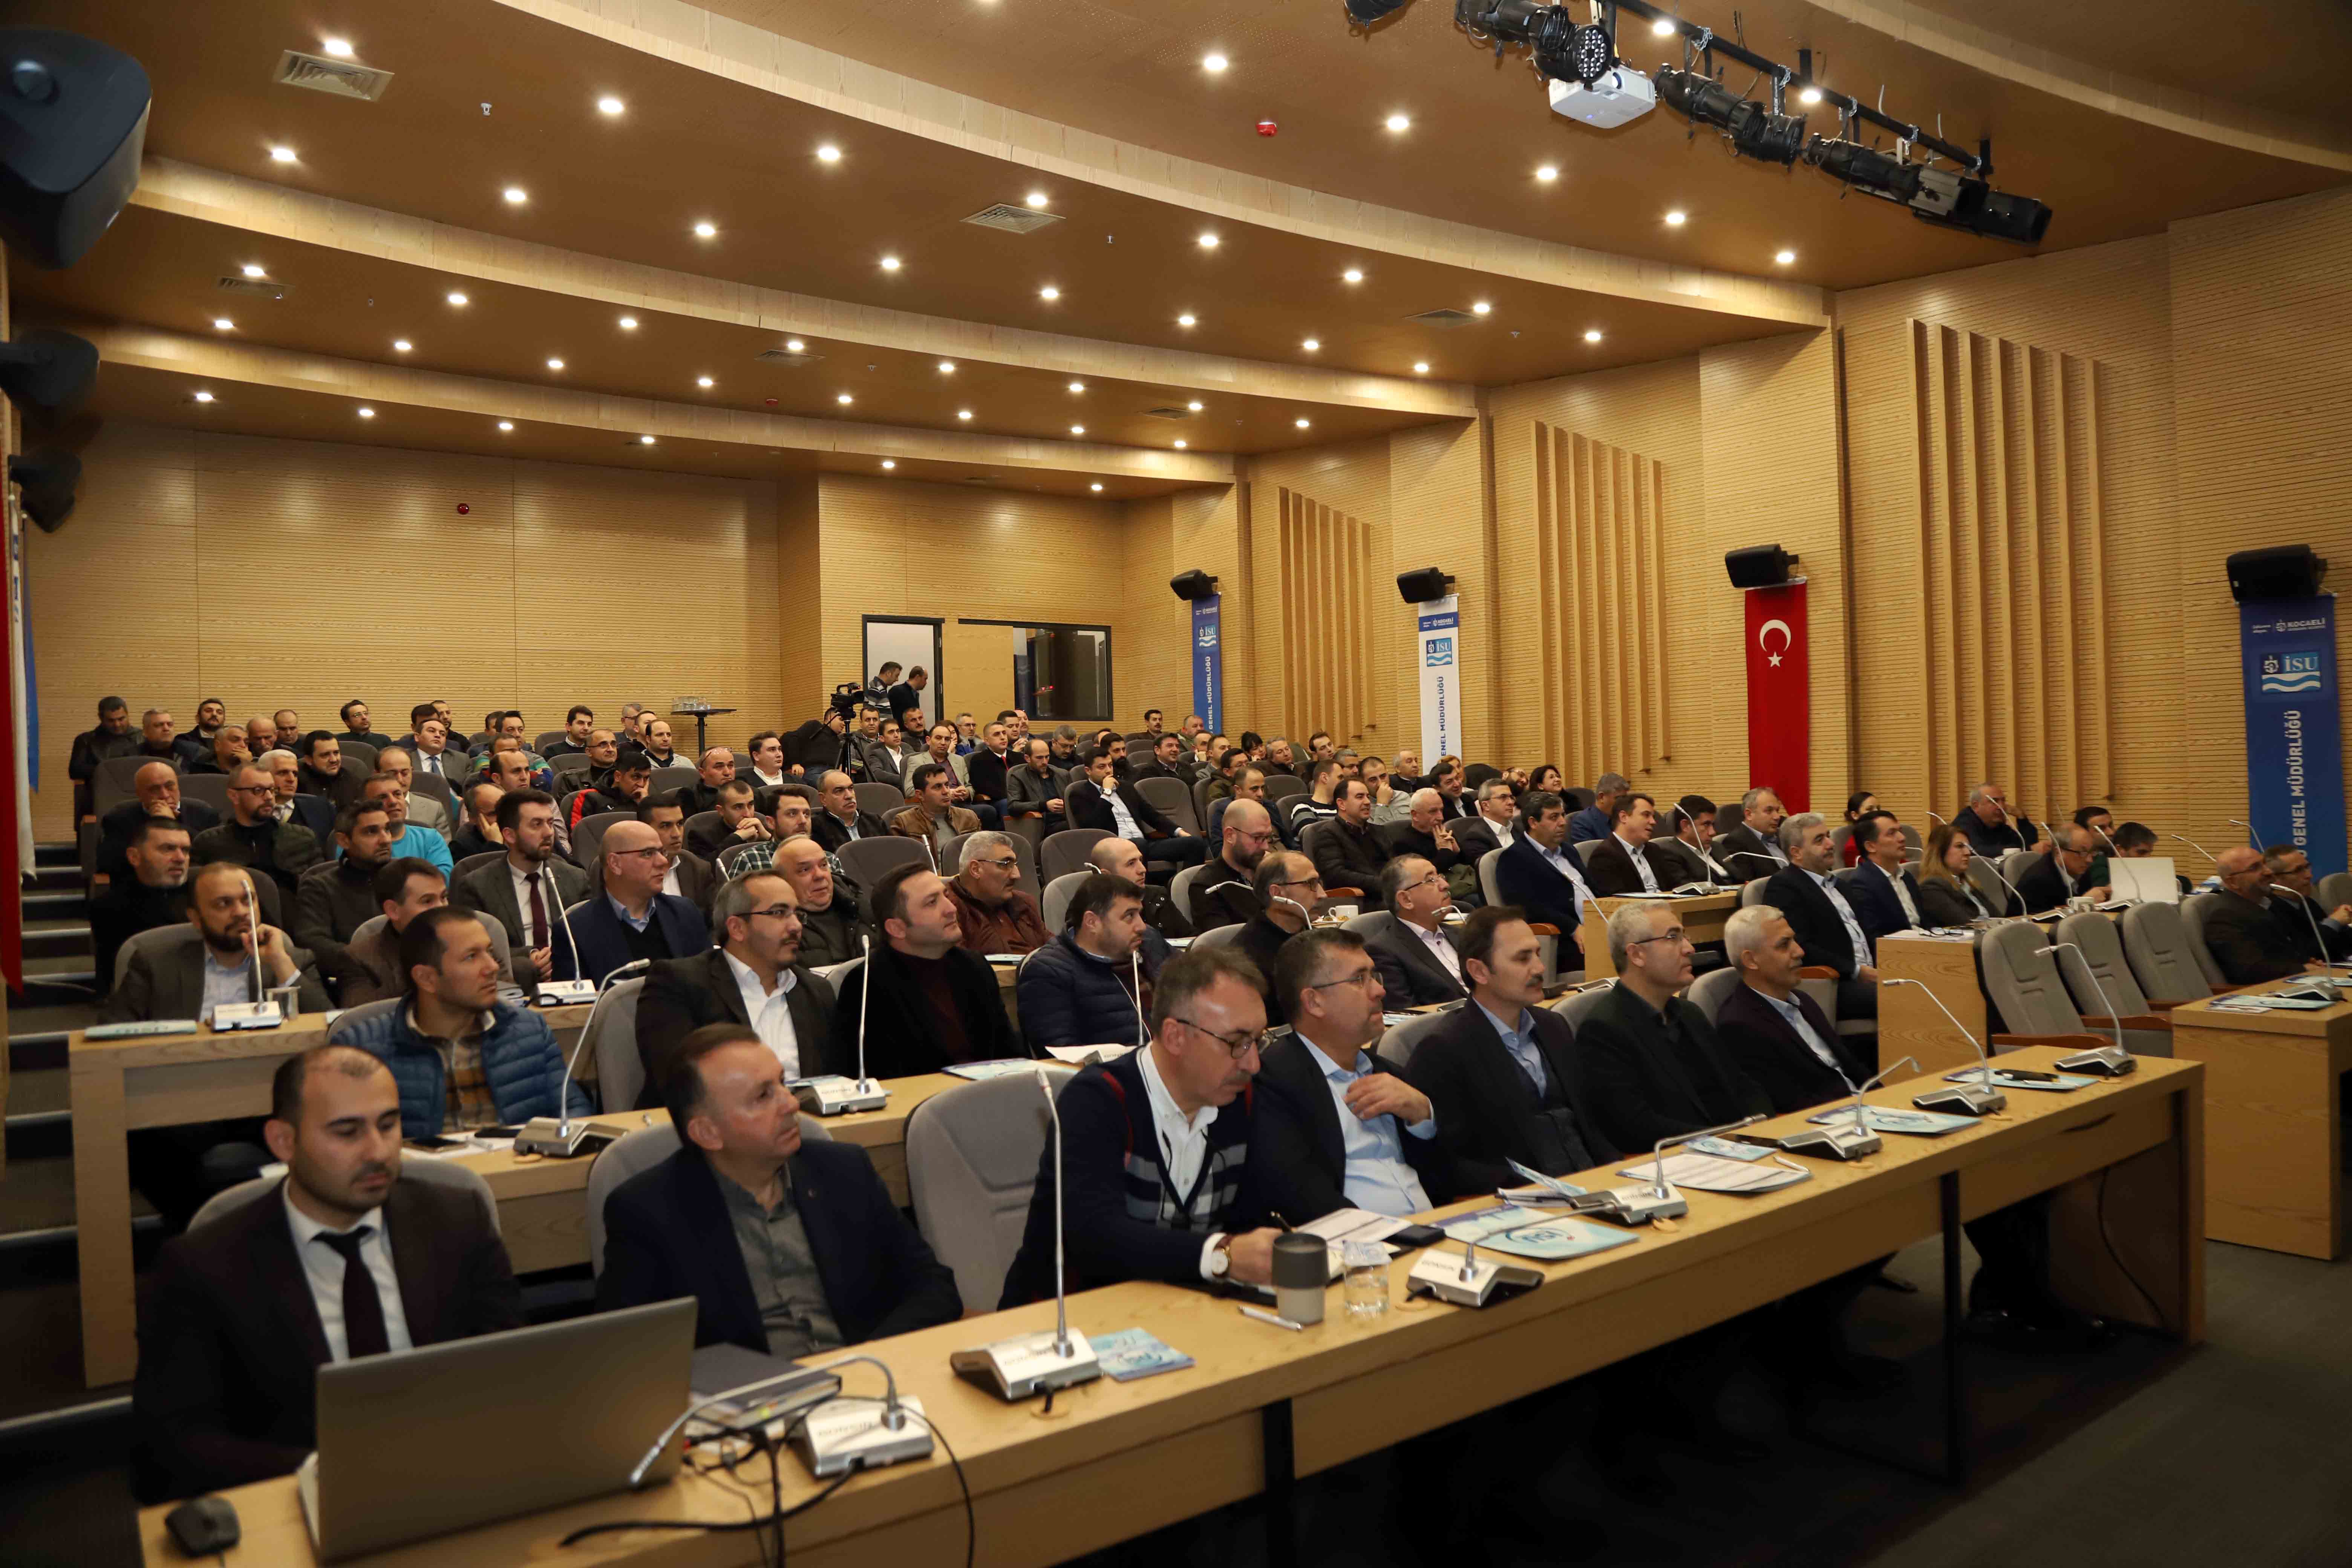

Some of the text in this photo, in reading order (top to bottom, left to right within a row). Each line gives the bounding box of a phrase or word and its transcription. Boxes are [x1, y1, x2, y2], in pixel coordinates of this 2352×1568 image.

[2287, 616, 2325, 628] KOCAELİ
[1436, 641, 1450, 652] İSU
[2285, 655, 2318, 671] İSU
[1436, 676, 1446, 731] MÜDÜRLÜĞÜ
[2283, 710, 2305, 796] MÜDÜRLÜĞÜ
[2291, 800, 2307, 846] GENEL
